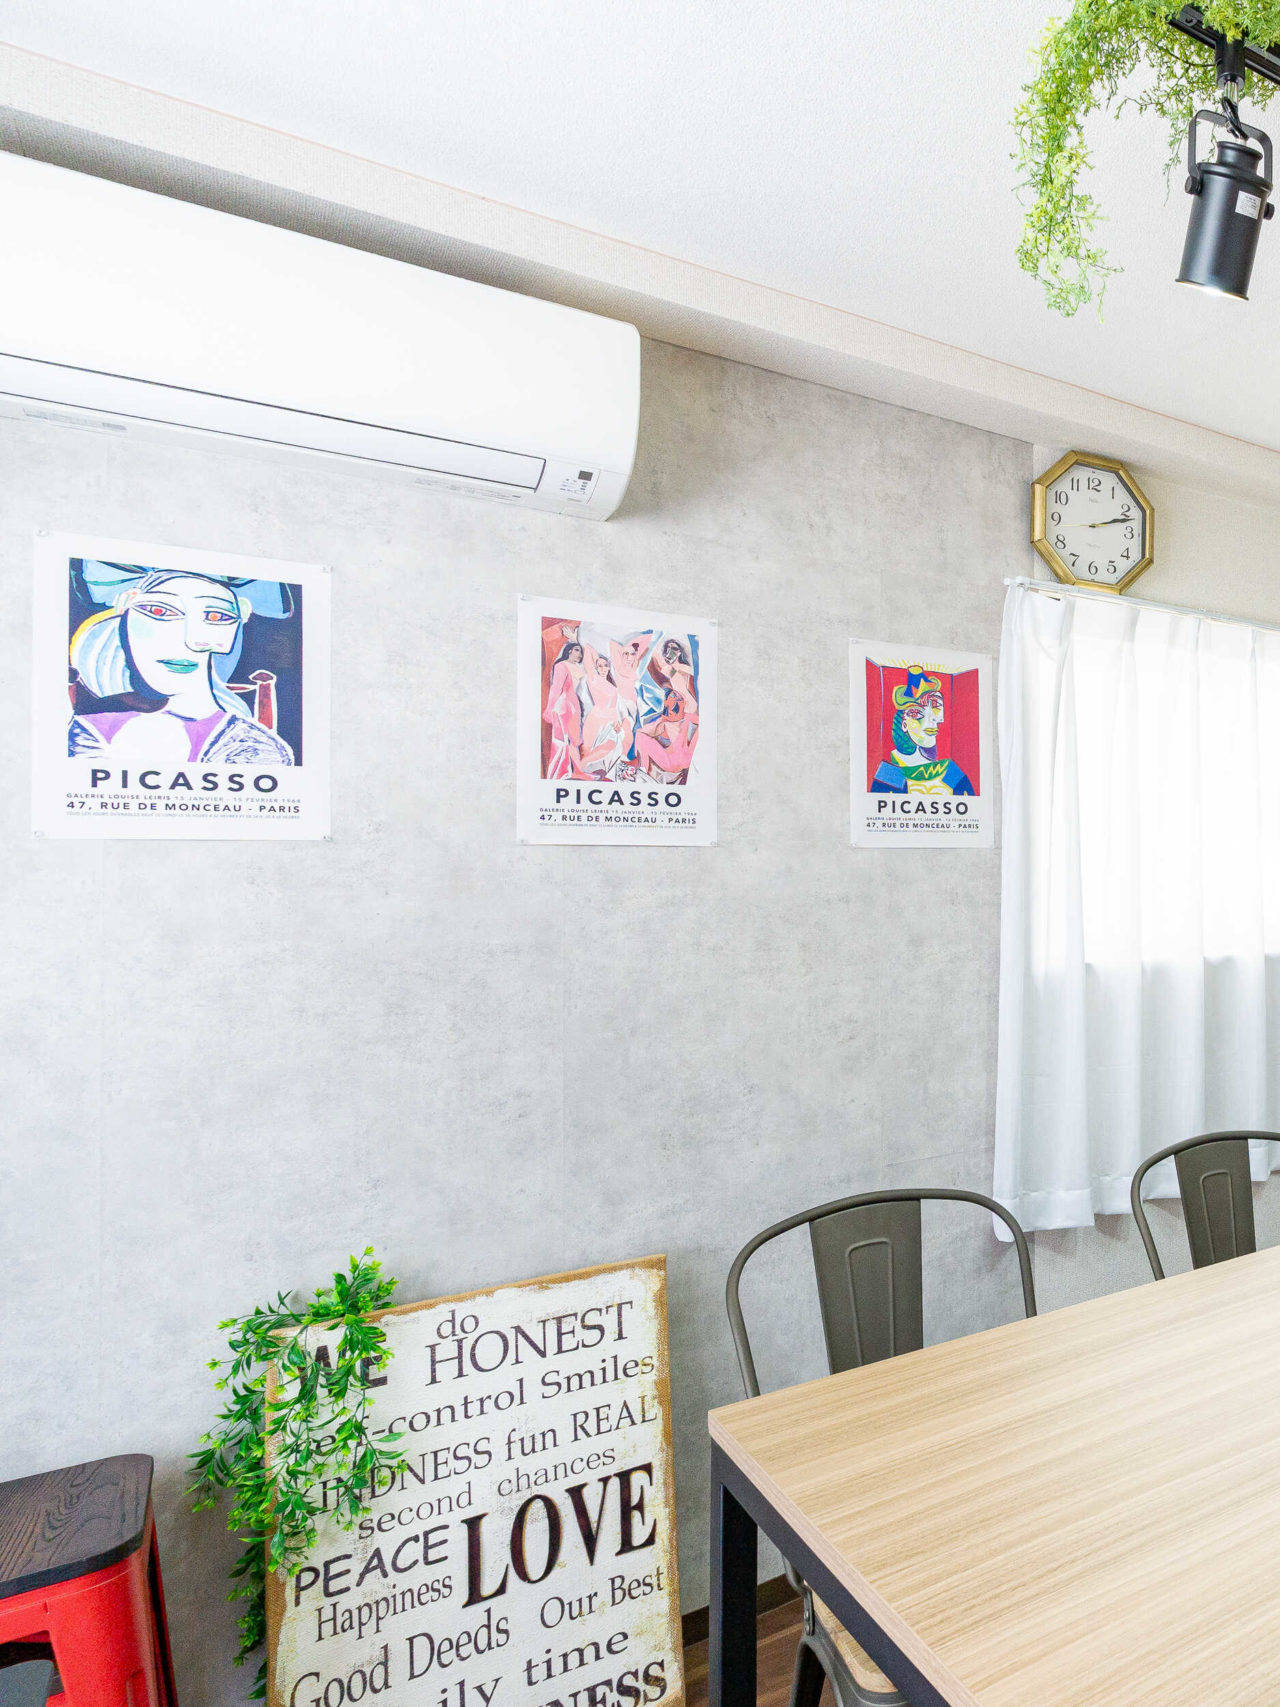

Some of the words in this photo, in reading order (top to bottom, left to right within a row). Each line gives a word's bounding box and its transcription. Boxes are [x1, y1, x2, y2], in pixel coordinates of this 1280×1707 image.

[1071, 477, 1080, 492] 11
[1087, 477, 1102, 492] 12
[1054, 490, 1069, 506] 10
[1111, 486, 1115, 499] 1
[1120, 504, 1131, 518] 2
[1051, 512, 1062, 526] 9
[1124, 526, 1134, 540] 3
[1055, 534, 1066, 549] 8
[1069, 553, 1079, 567] 7
[1120, 547, 1131, 560] 4
[1088, 561, 1098, 575] 6
[1107, 560, 1117, 574] 5
[91, 769, 278, 793] PICASSO
[556, 788, 682, 808] PICASSO
[67, 801, 92, 811] 47,
[100, 802, 131, 810] RUE
[138, 803, 158, 811] DE
[165, 803, 242, 812] MONCEAU
[259, 805, 300, 814] PARIS
[878, 800, 968, 815] PICASSO
[605, 816, 657, 824] MONCEAU
[668, 817, 697, 825] PARIS
[436, 1309, 479, 1340] do
[425, 1301, 633, 1386] HONEST
[541, 1355, 655, 1399] Smiles
[505, 1428, 559, 1461] fun
[570, 1395, 658, 1443] REAL
[358, 1481, 474, 1540] second
[497, 1448, 616, 1497] chances
[294, 1524, 450, 1607] PEACE
[460, 1461, 658, 1609] LOVE
[315, 1575, 453, 1643] Happiness
[289, 1643, 392, 1707] Good
[405, 1608, 511, 1682] Deeds
[540, 1590, 599, 1629] Our
[608, 1565, 666, 1607] Best
[522, 1631, 629, 1687] time
